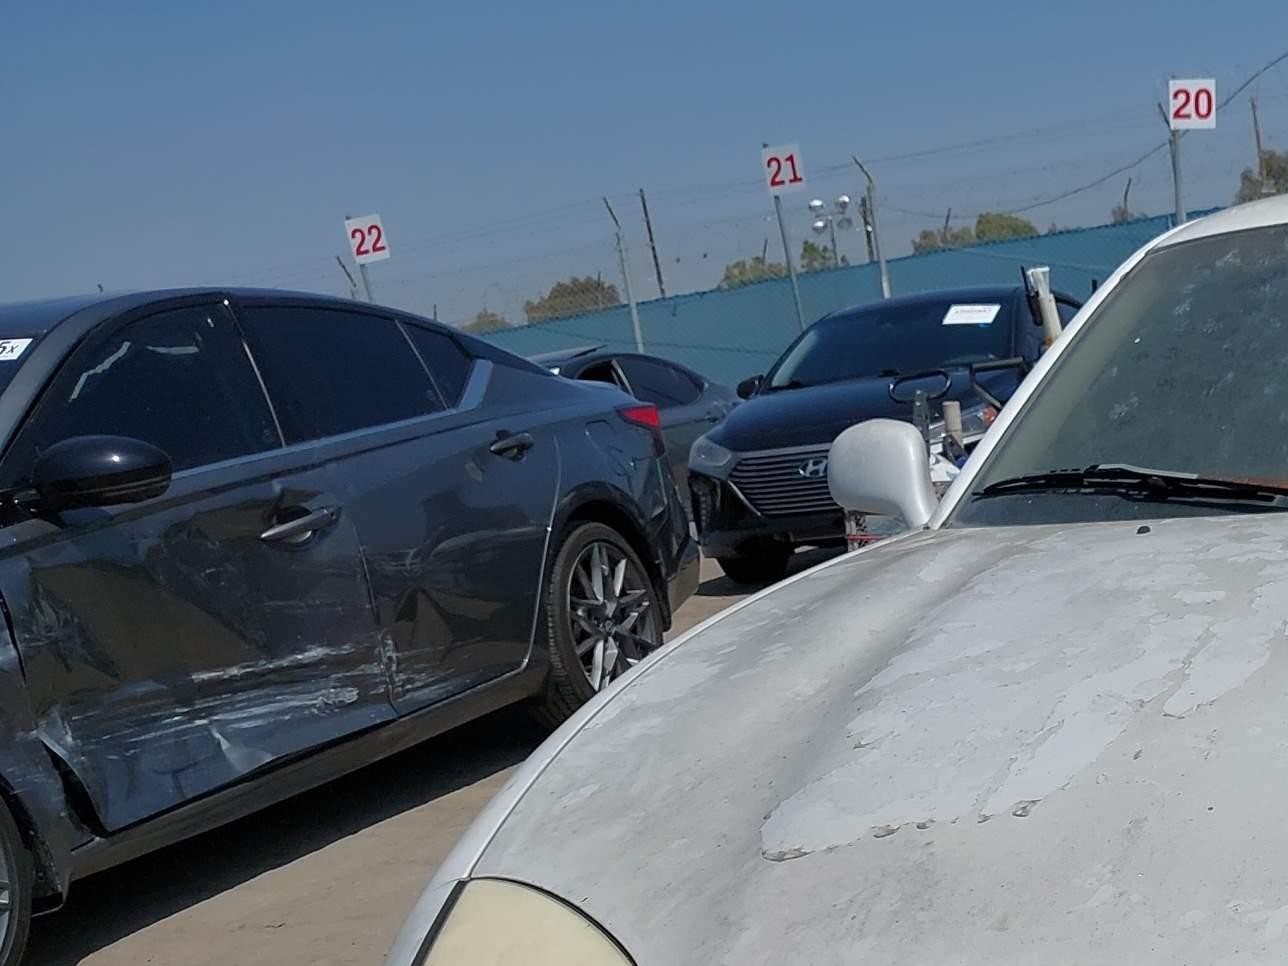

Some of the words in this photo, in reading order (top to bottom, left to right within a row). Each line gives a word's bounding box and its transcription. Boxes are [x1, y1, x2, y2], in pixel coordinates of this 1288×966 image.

[1172, 88, 1213, 120] 20
[767, 153, 803, 187] 21
[351, 224, 386, 256] 22
